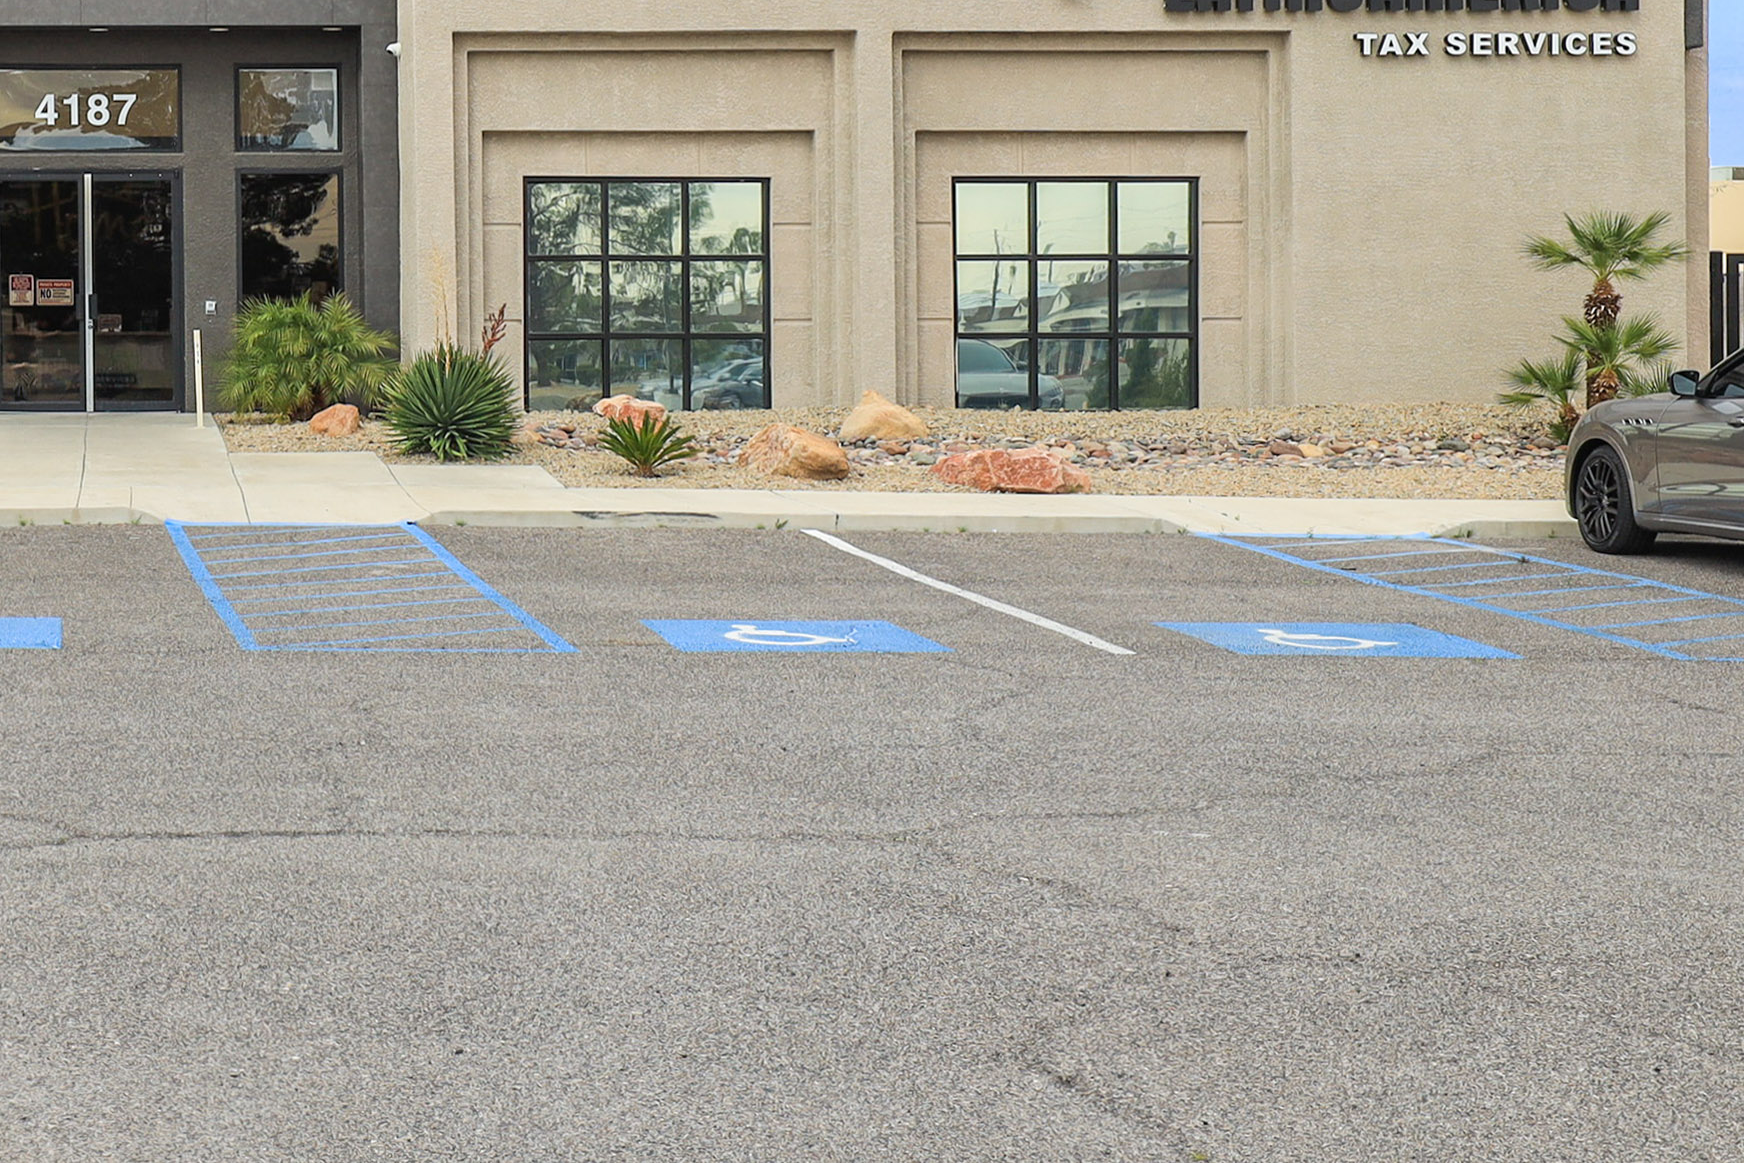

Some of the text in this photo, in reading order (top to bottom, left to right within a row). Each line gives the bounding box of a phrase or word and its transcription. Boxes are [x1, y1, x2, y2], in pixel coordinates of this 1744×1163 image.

[1355, 31, 1638, 57] TAX SERVICES
[34, 92, 138, 127] 4187
[40, 288, 52, 299] NO
